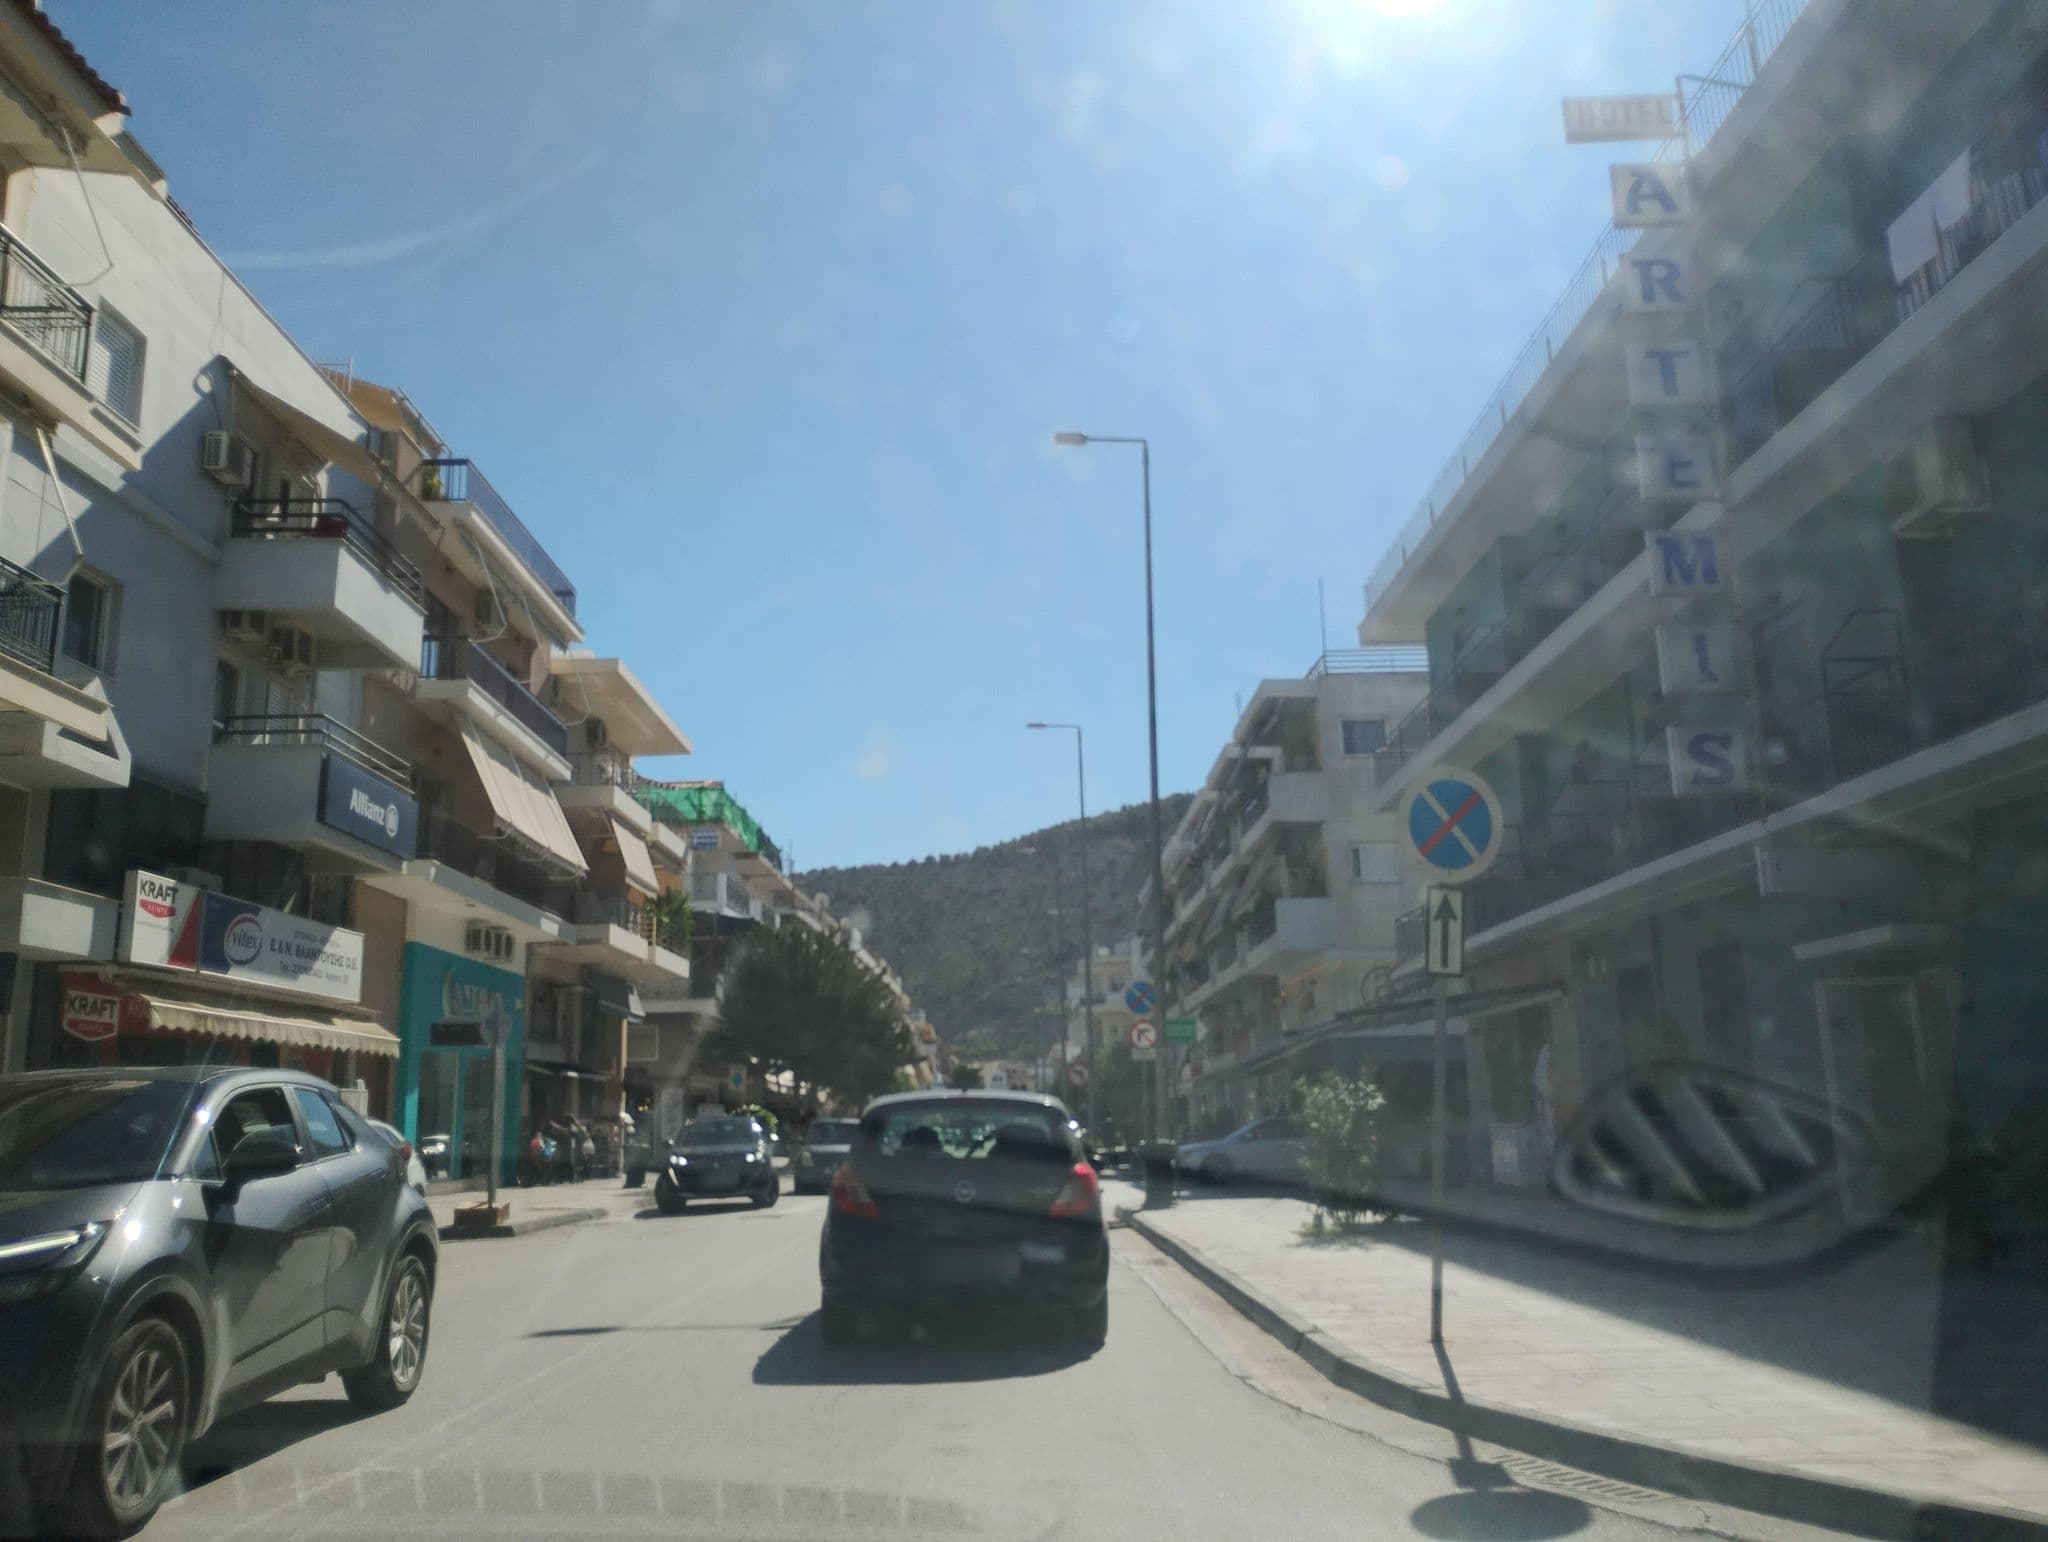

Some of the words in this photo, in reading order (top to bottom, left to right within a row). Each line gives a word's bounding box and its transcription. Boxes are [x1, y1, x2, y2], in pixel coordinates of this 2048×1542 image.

[1625, 170, 1736, 786] ARTEMIS
[350, 788, 386, 826] Allianz
[140, 880, 178, 904] KRAFT
[232, 929, 258, 949] vitex
[68, 994, 117, 1018] KRAFT
